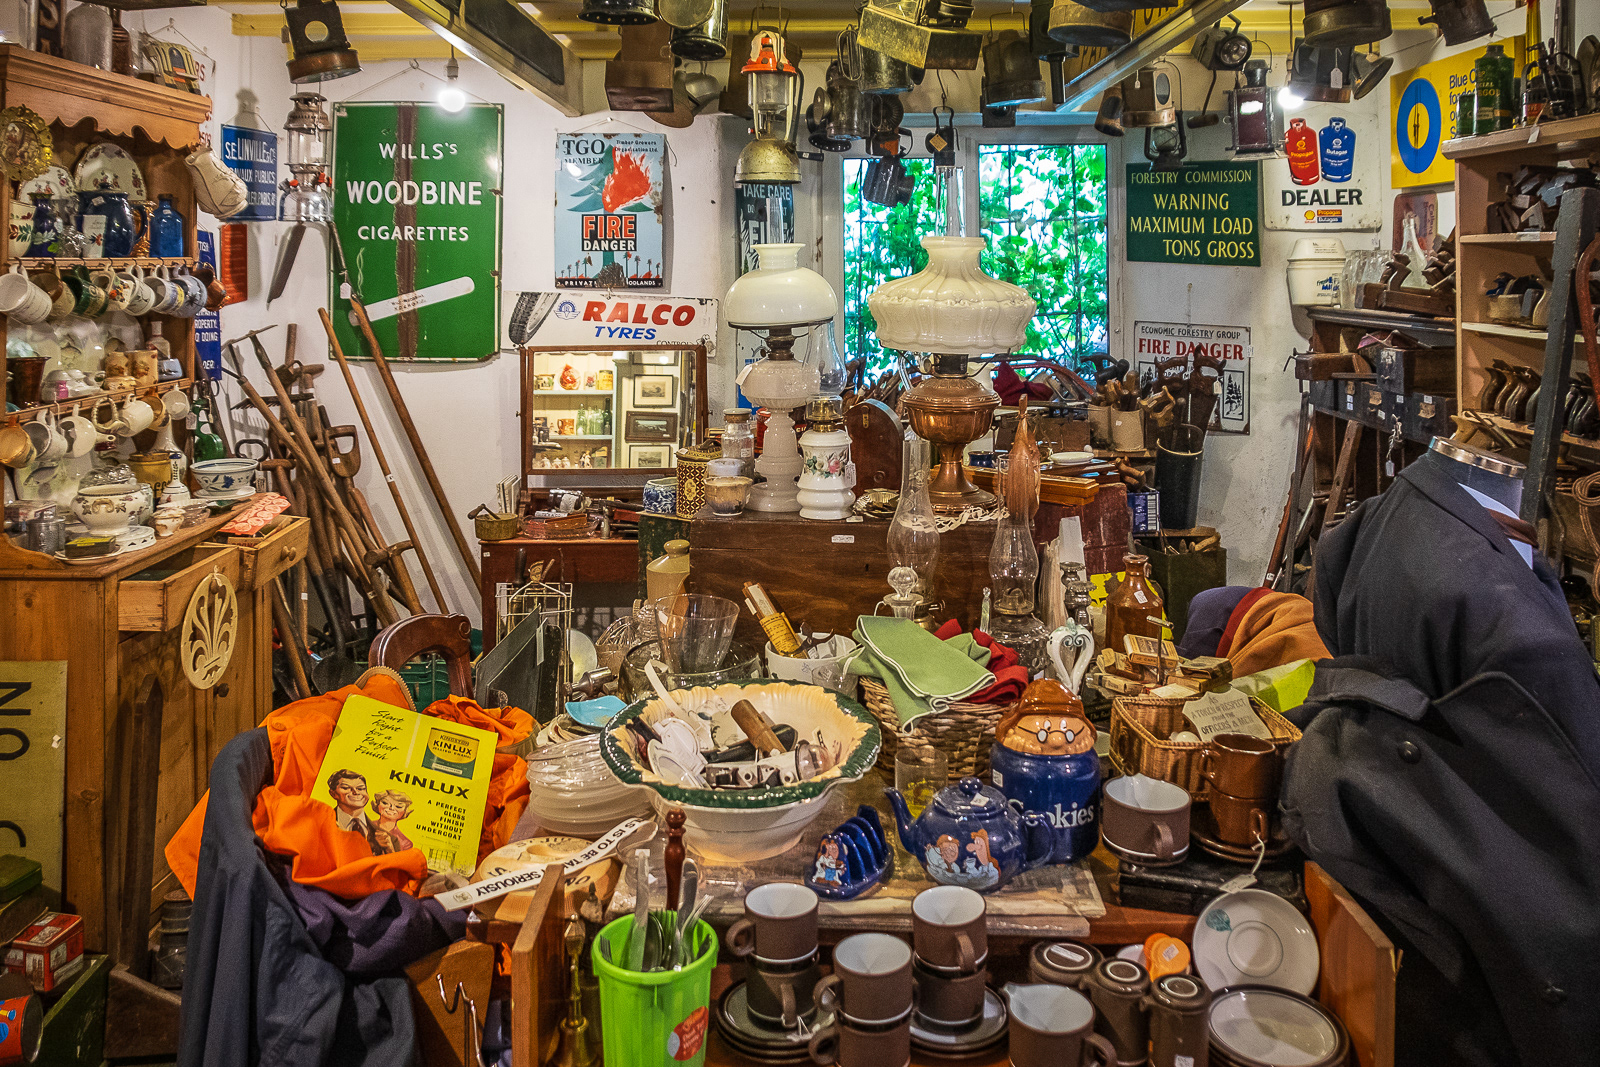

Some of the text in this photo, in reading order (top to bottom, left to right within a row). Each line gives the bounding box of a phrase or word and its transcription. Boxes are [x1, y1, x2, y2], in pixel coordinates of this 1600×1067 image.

[1449, 74, 1468, 89] Blue
[563, 139, 605, 155] TGO
[1326, 148, 1348, 156] Butagas
[254, 169, 276, 184] PUBLICS
[1131, 170, 1252, 184] FORESTRY COMMISSION
[346, 180, 482, 205] WOODBINE
[741, 183, 791, 200] TAKE CARE
[1281, 188, 1363, 206] DEALER
[1153, 193, 1229, 210] WARNING
[583, 215, 635, 239] FIRE
[1130, 216, 1253, 235] MAXIMUM LOAD
[357, 225, 469, 242] CIGARETTES
[583, 240, 635, 251] DANGER
[1162, 239, 1254, 259] TONS GROSS
[582, 300, 696, 327] RALCO
[194, 319, 218, 329] ROPERTY.
[201, 332, 219, 342] DOING
[594, 325, 657, 340] TYRES
[1141, 325, 1241, 340] ECONOMIC FORESTRY GROUP
[1138, 338, 1244, 360] FIRE DANGER
[1190, 711, 1196, 720] A
[1196, 705, 1217, 718] TOKEN
[1220, 698, 1247, 712] RESPECT
[371, 711, 404, 723] Start
[365, 728, 384, 737] for
[372, 719, 403, 732] Right
[1201, 719, 1231, 735] OFFICERS
[362, 737, 399, 752] Perfect
[433, 740, 472, 755] KINLUX
[355, 745, 388, 760] Finish
[389, 770, 470, 800] KINLUX
[436, 801, 466, 814] PERFECT
[440, 816, 465, 828] FINISH
[444, 810, 466, 821] GLOSS
[416, 823, 462, 841] UNDERCOAT
[430, 820, 463, 834] WITHOUT
[612, 828, 626, 838] IS
[597, 838, 616, 850] TO
[580, 849, 599, 860] BE
[476, 870, 541, 896] SERIOUSLY
